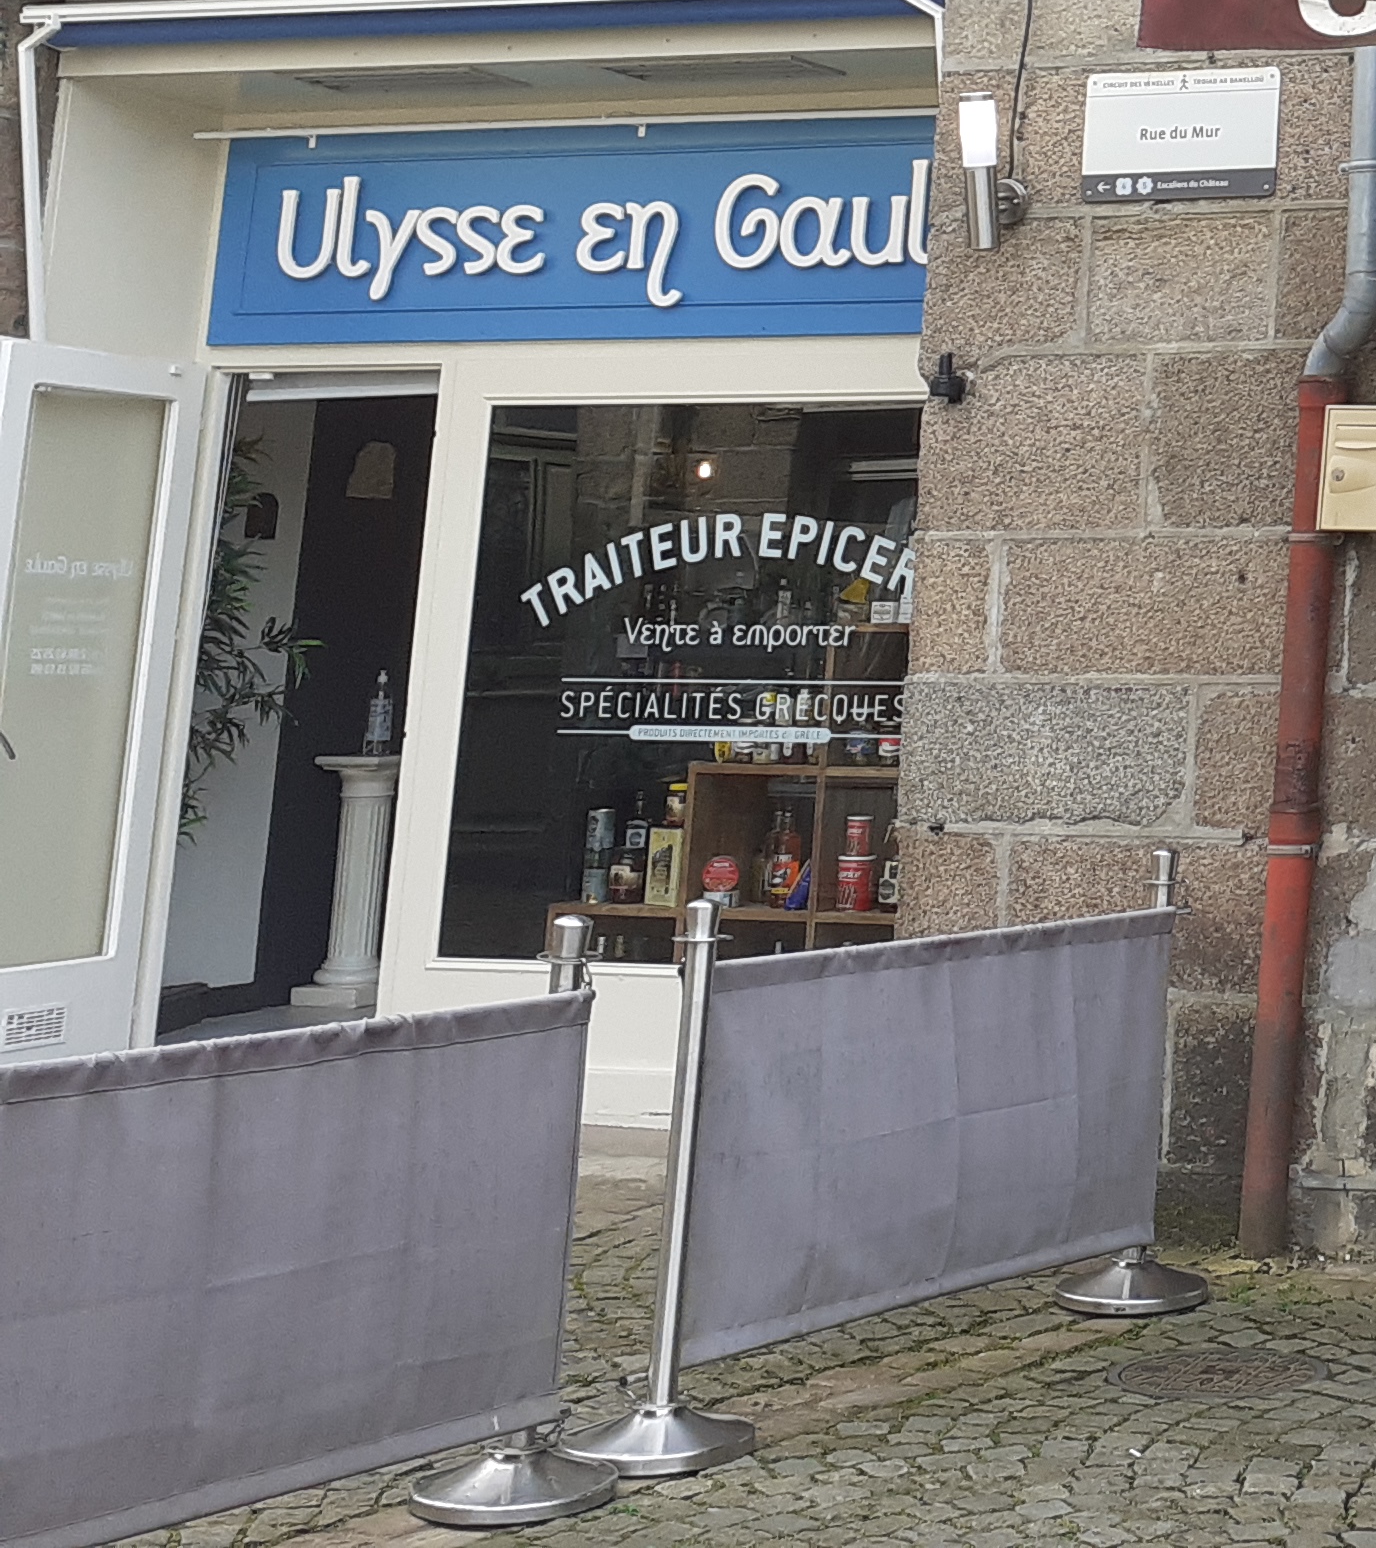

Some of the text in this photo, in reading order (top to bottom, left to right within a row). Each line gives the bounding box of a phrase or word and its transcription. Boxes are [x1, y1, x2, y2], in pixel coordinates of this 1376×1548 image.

[1139, 125, 1221, 141] Rue du Mur
[277, 175, 545, 302] Ulysse
[576, 200, 683, 307] en
[520, 513, 743, 628] TRAITEUR
[624, 617, 856, 653] Vente à emporter
[560, 686, 743, 720] SPÉCIALITÉS
